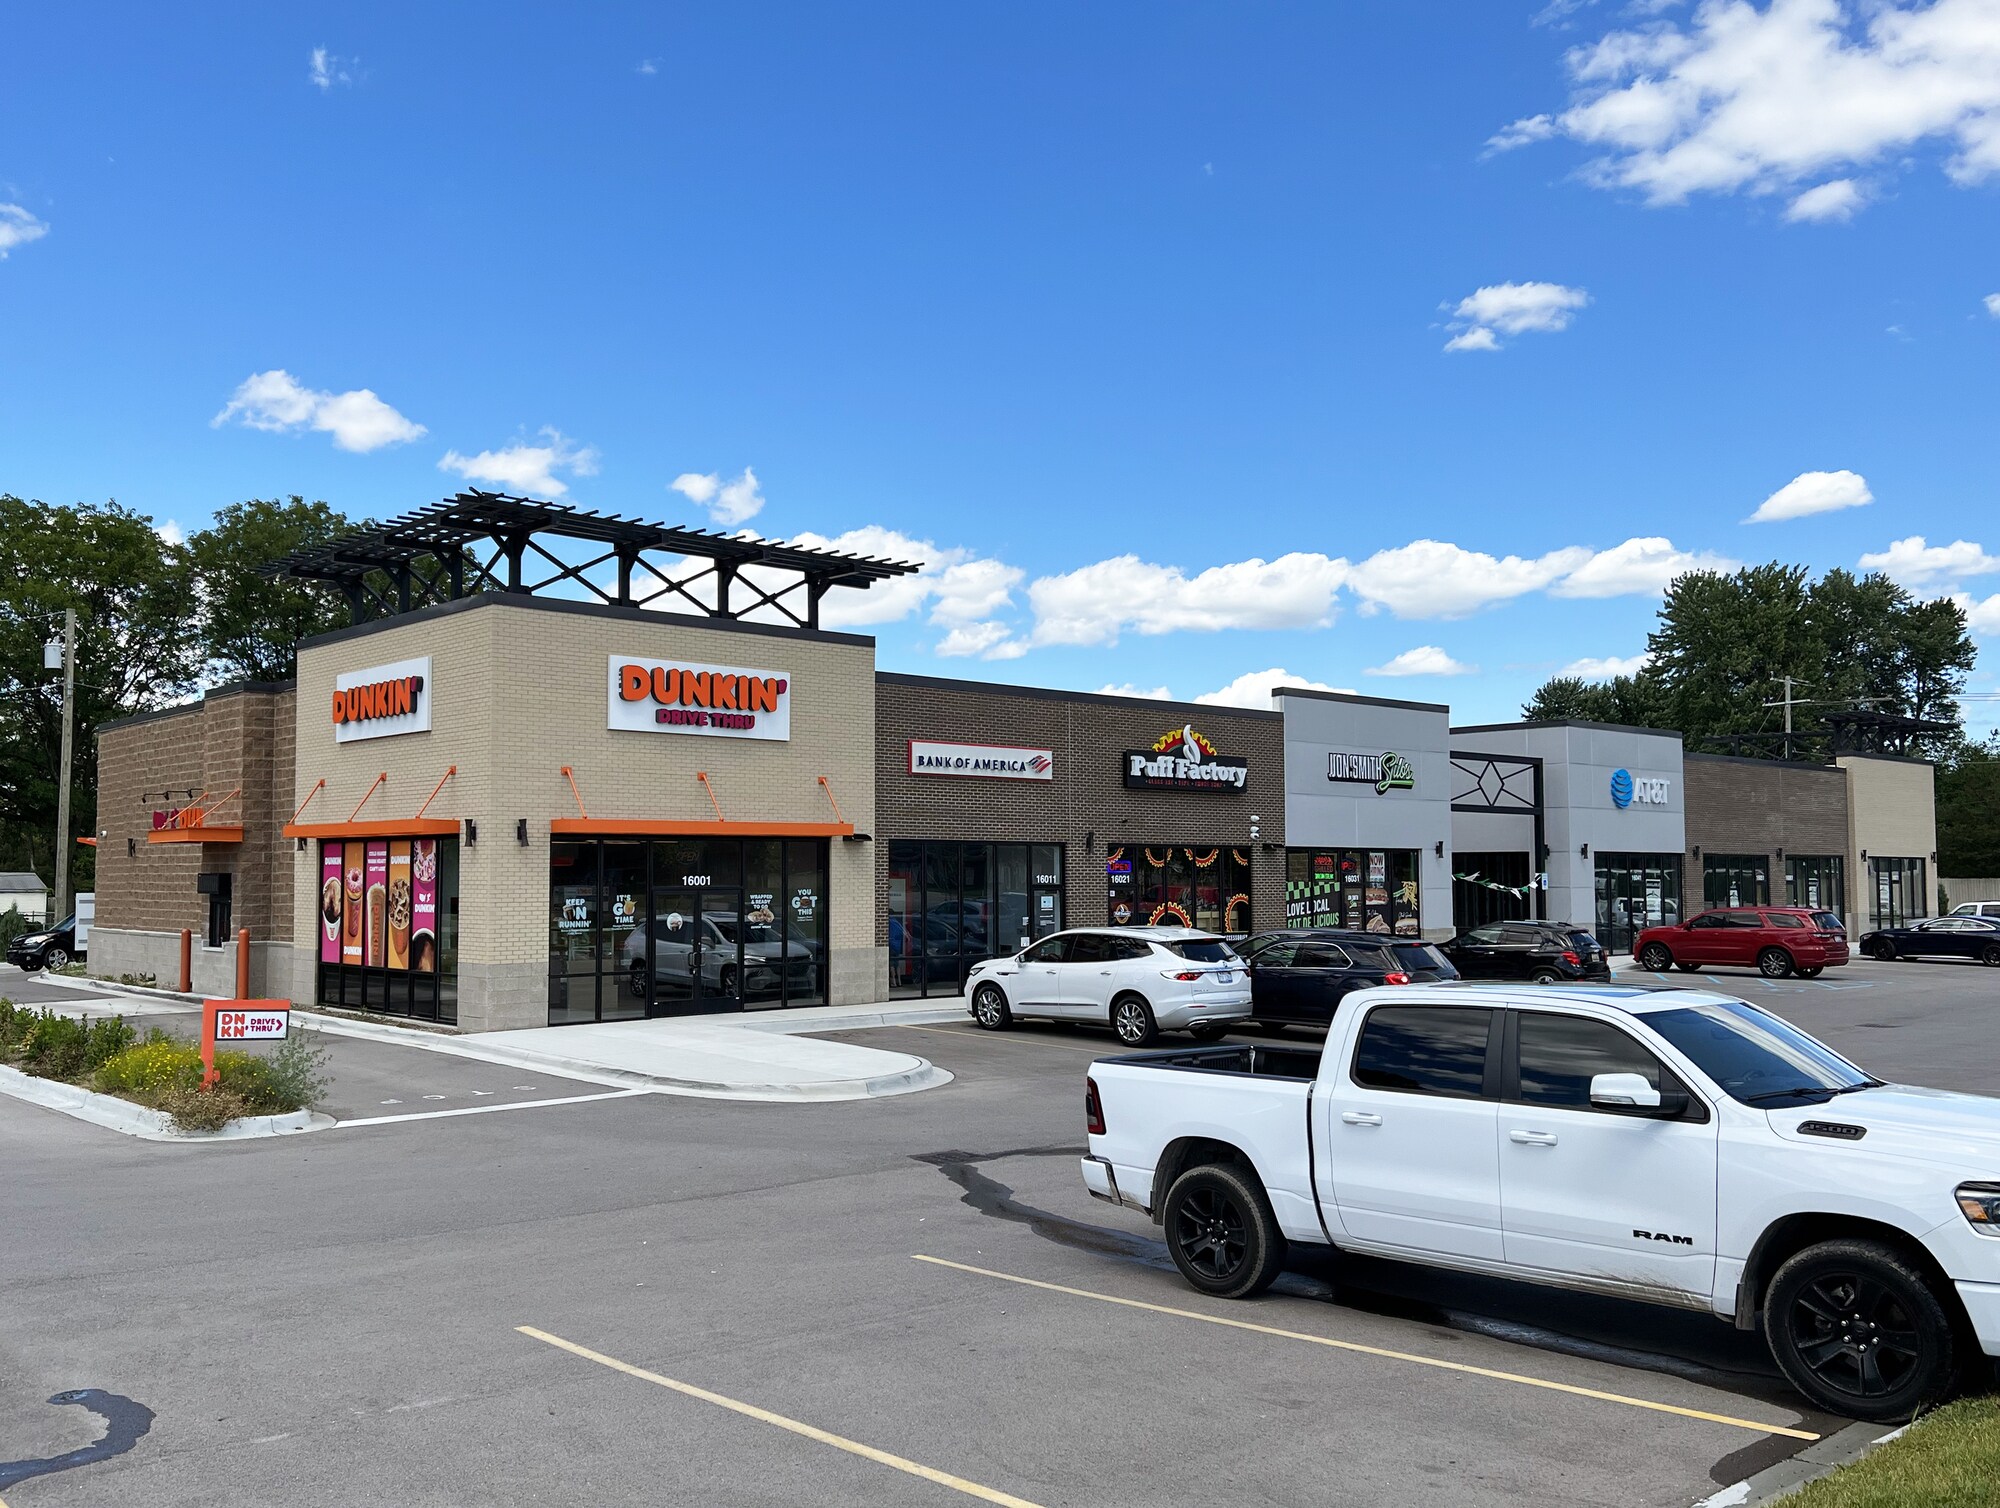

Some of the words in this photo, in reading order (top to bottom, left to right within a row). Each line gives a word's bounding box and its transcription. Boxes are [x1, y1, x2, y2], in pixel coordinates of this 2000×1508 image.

[618, 664, 788, 713] DUNKIN'
[332, 675, 424, 725] DUNKIN'
[656, 708, 709, 727] DRIVE
[709, 712, 756, 730] THRU
[917, 755, 952, 769] BANK
[954, 757, 971, 770] OF
[973, 758, 1027, 773] AMERICA
[1349, 755, 1382, 781] SMITH
[1130, 755, 1176, 778] Puff
[1175, 757, 1248, 788] Factory
[1633, 777, 1671, 804] AT&T
[681, 875, 712, 887] 16001
[1036, 874, 1057, 884] 16011
[1110, 875, 1130, 884] 16021
[1344, 874, 1360, 883] 16031
[616, 894, 632, 902] IT'S
[797, 888, 812, 896] YOU
[565, 898, 586, 906] KEEP
[791, 895, 818, 909] GOT
[797, 908, 813, 916] THIS
[1286, 902, 1305, 917] LOVE
[559, 920, 592, 929] RUNNIN'
[614, 915, 635, 924] TIME
[221, 1013, 246, 1026] DN
[221, 1025, 249, 1038] KN'
[1632, 1229, 1694, 1246] RAM
